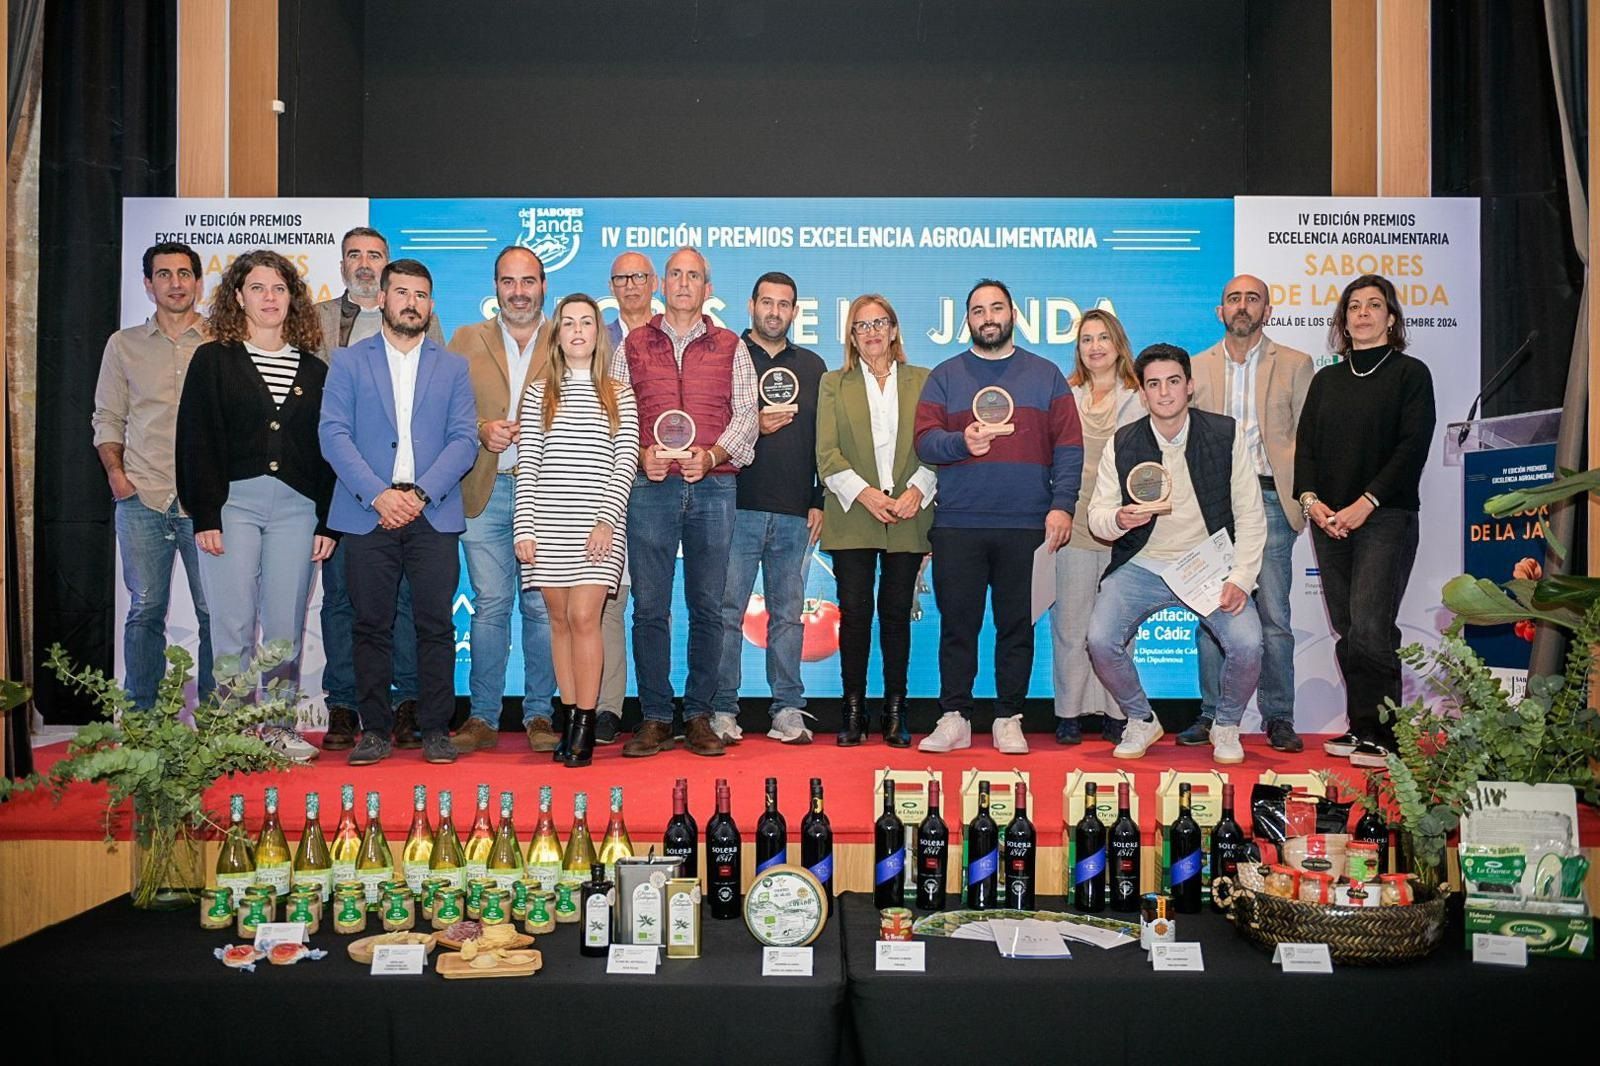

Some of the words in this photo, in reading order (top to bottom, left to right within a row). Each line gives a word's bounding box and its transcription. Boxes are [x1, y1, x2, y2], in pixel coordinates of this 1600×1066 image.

[185, 214, 197, 227] IV
[200, 211, 246, 227] EDICIÓN
[250, 214, 302, 227] PREMIOS
[536, 208, 584, 217] SABORES
[1298, 213, 1310, 226] IV
[1313, 211, 1360, 226] EDICIÓN
[1363, 213, 1415, 226] PREMIOS
[525, 207, 584, 242] Janda
[155, 232, 224, 245] EXCELENCIA
[228, 232, 335, 245] AGROALIMENTARIA
[601, 227, 621, 247] IV
[626, 223, 702, 247] EDICIÓN
[708, 227, 794, 248] PREMIOS
[799, 226, 914, 248] EXCELENCIA
[919, 227, 1098, 248] AGROALIMENTARIA
[1268, 232, 1339, 245] EXCELENCIA
[1341, 232, 1450, 245] AGROALIMENTARIA
[1304, 254, 1424, 276] SABORES
[1269, 284, 1302, 306] DE
[1311, 284, 1342, 306] LA
[1396, 284, 1449, 306] NDA
[1294, 317, 1306, 326] DE
[1308, 317, 1325, 326] LOS
[1437, 317, 1457, 328] 2024
[1526, 464, 1547, 473] PREMIOS
[1491, 476, 1518, 484] EXCELENCIA
[1470, 524, 1490, 542] DE
[1495, 523, 1515, 540] LA
[1154, 625, 1191, 641] Cádiz
